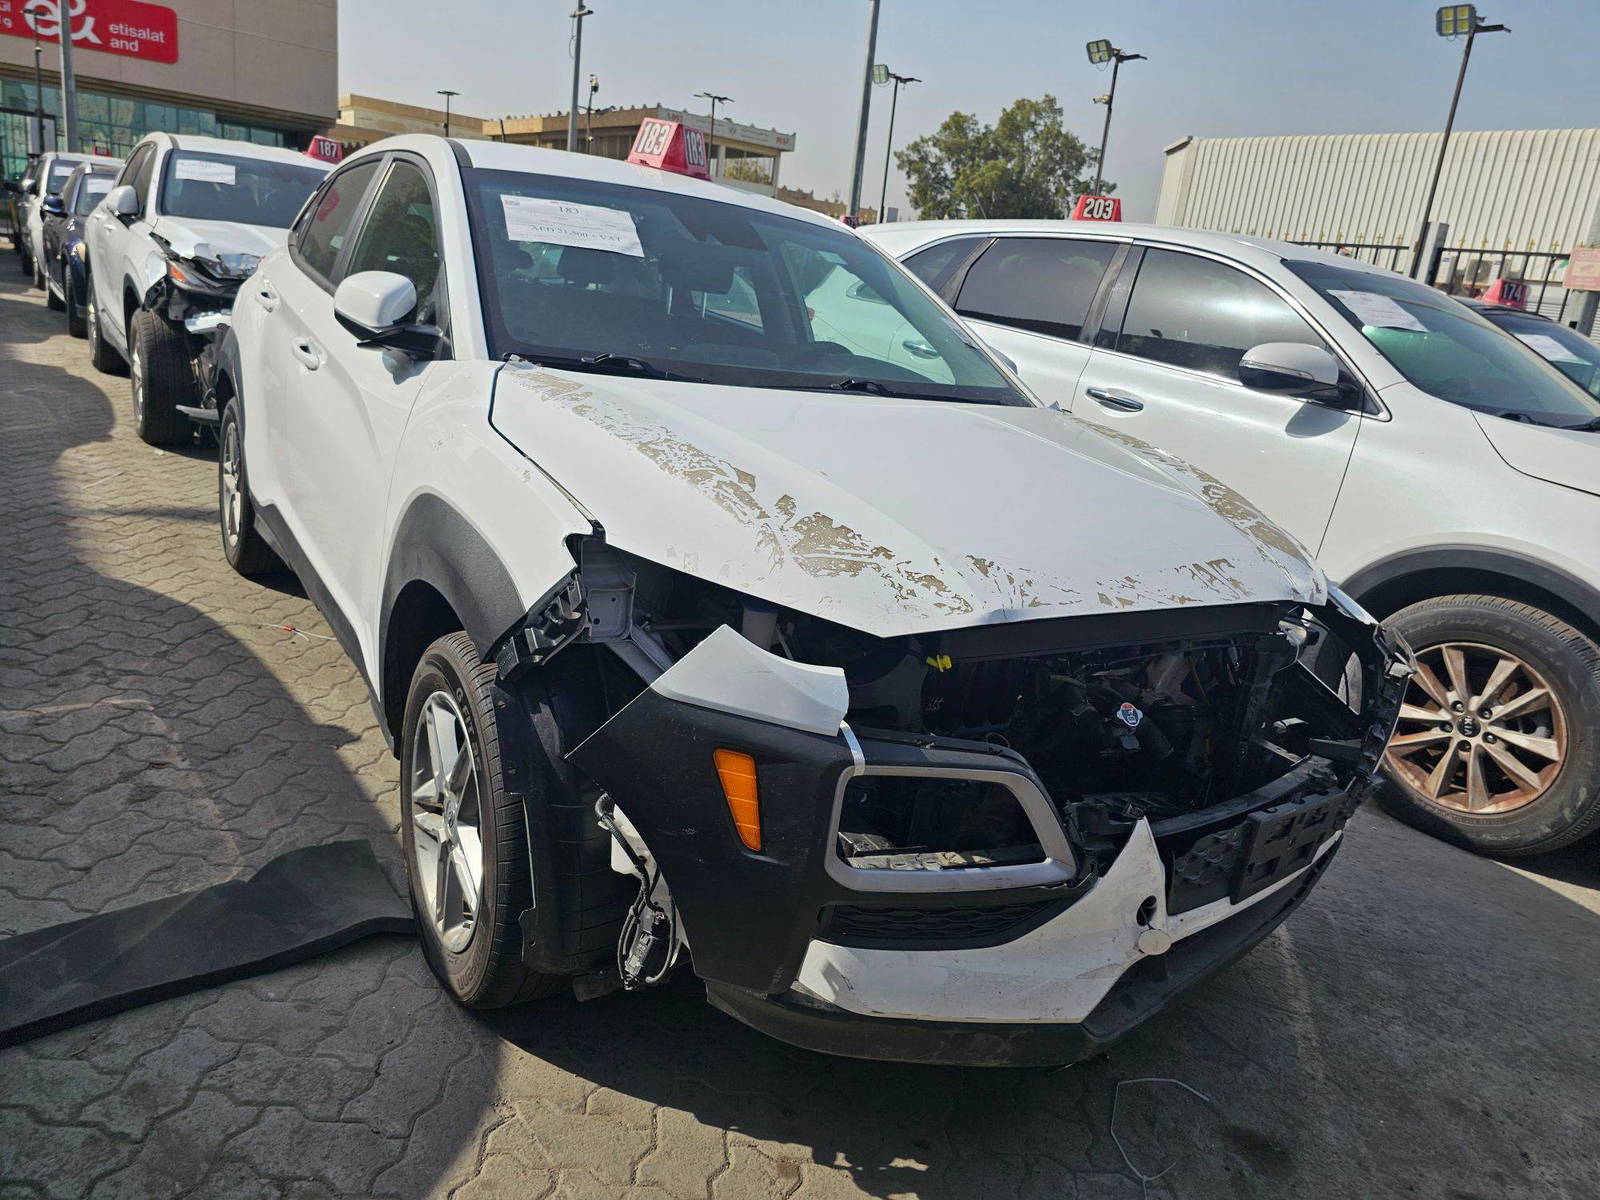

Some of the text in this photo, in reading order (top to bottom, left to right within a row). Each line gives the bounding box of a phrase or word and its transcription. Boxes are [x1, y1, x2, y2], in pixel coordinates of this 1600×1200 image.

[109, 23, 165, 43] etisalat
[110, 38, 139, 51] and
[637, 123, 670, 155] 183
[686, 130, 704, 166] 183
[319, 141, 337, 158] 187
[1083, 198, 1114, 220] 203
[1503, 283, 1522, 302] 174
[1464, 718, 1473, 735] KIA
